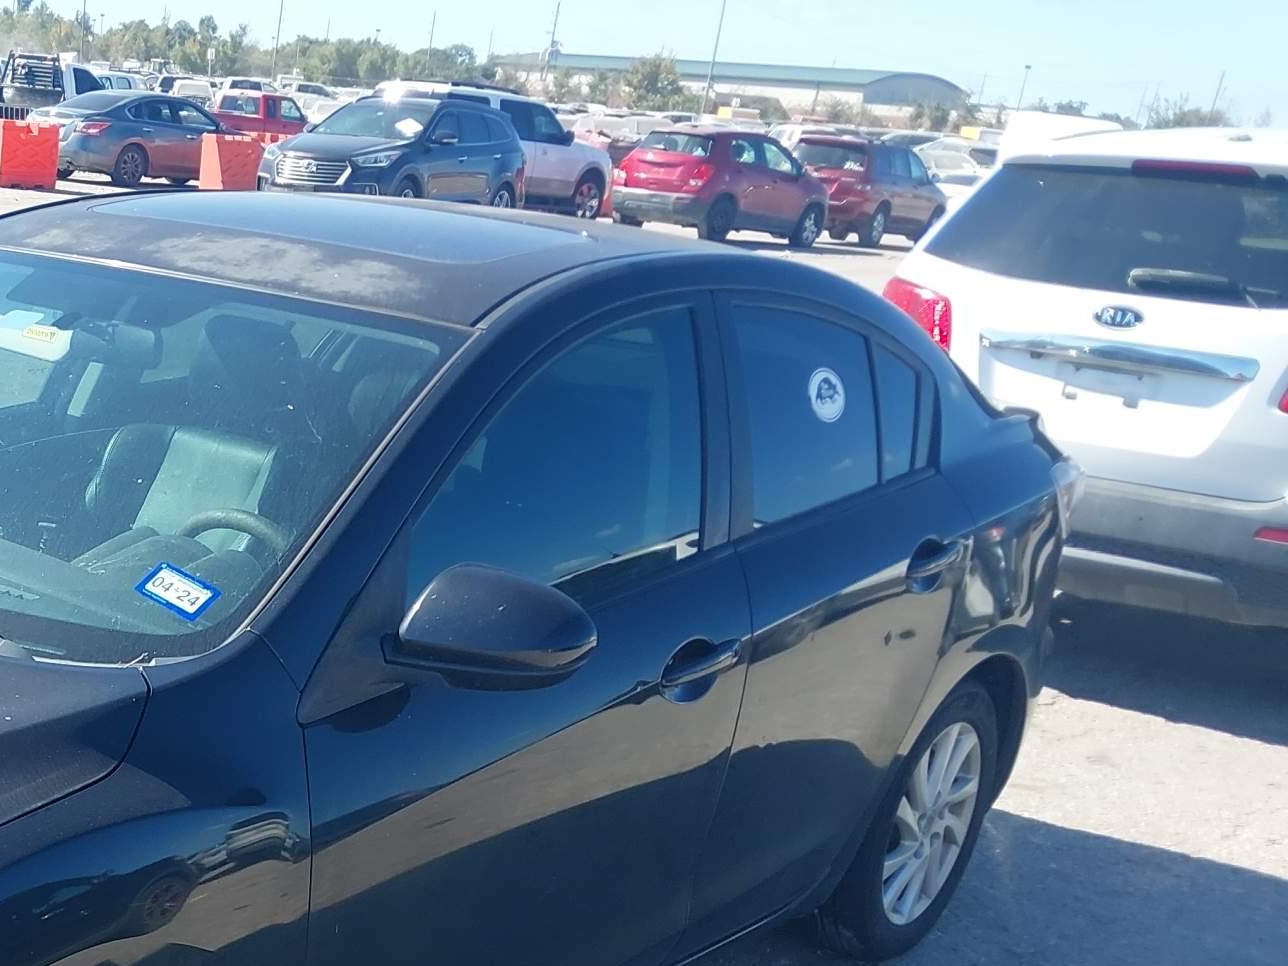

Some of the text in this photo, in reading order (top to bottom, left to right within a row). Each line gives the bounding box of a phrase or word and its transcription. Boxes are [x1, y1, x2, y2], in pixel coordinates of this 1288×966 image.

[1101, 308, 1136, 326] KIA
[151, 577, 174, 593] 04
[176, 590, 200, 606] 24
